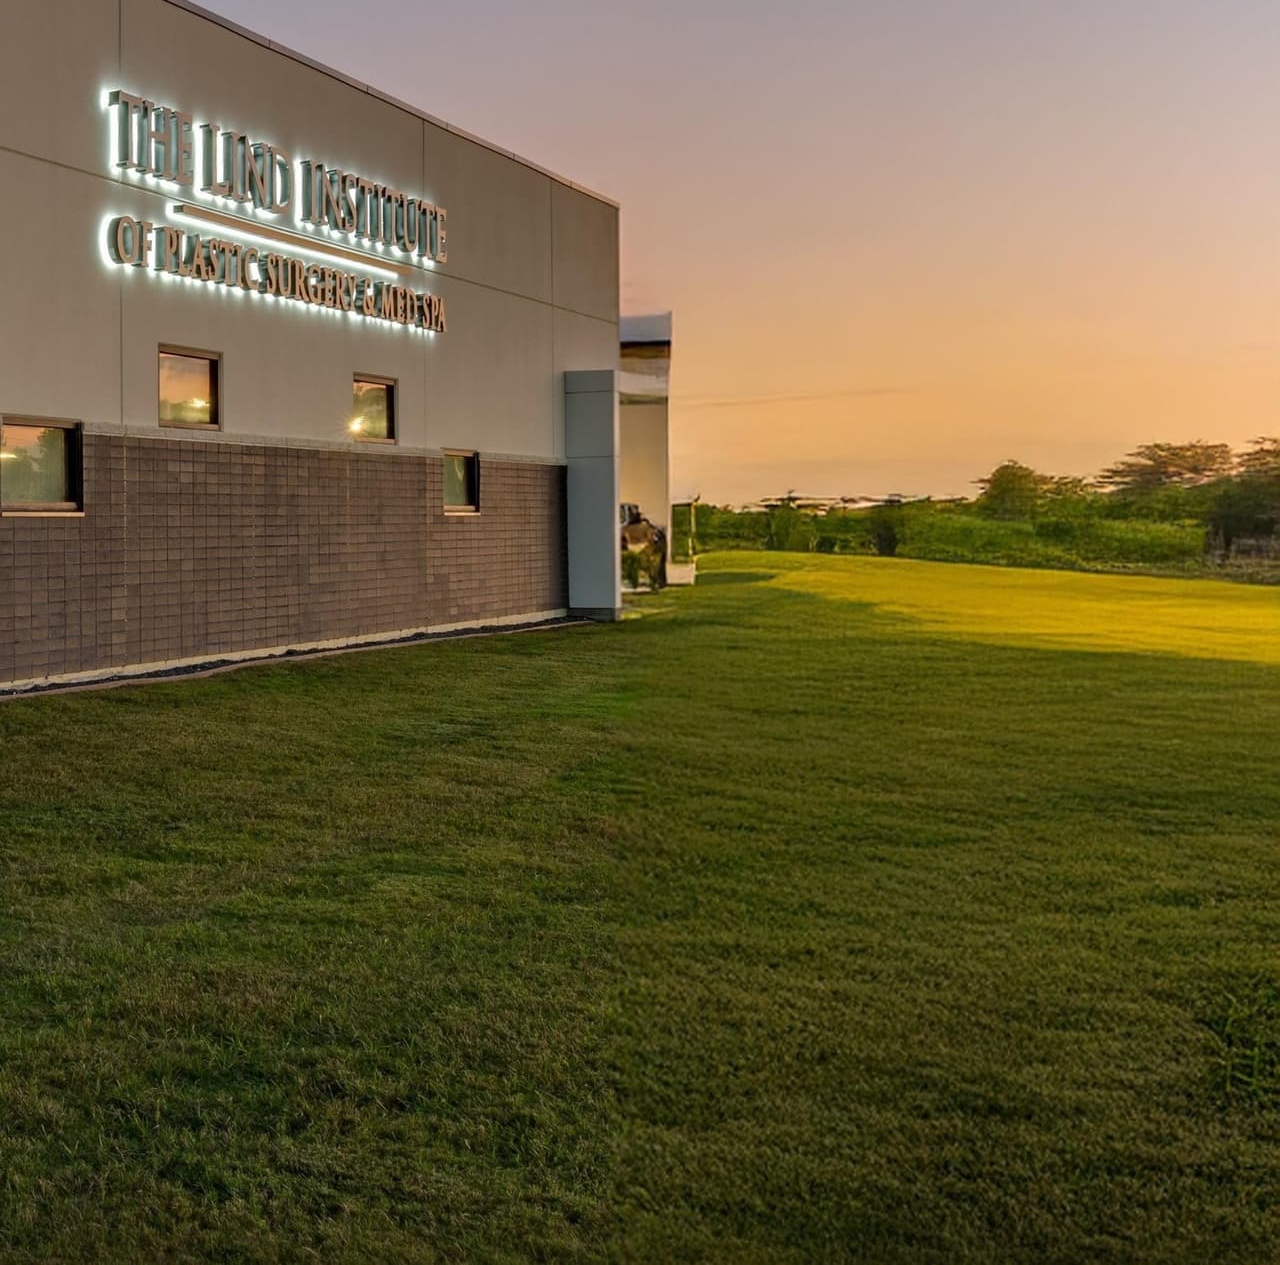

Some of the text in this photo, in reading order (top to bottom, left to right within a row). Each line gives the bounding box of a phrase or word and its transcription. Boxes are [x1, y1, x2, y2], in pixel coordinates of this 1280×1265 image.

[109, 89, 448, 264] THE LIND INSTITUTE
[109, 214, 447, 334] OF PLASTIC SURGERY & MED SPA
